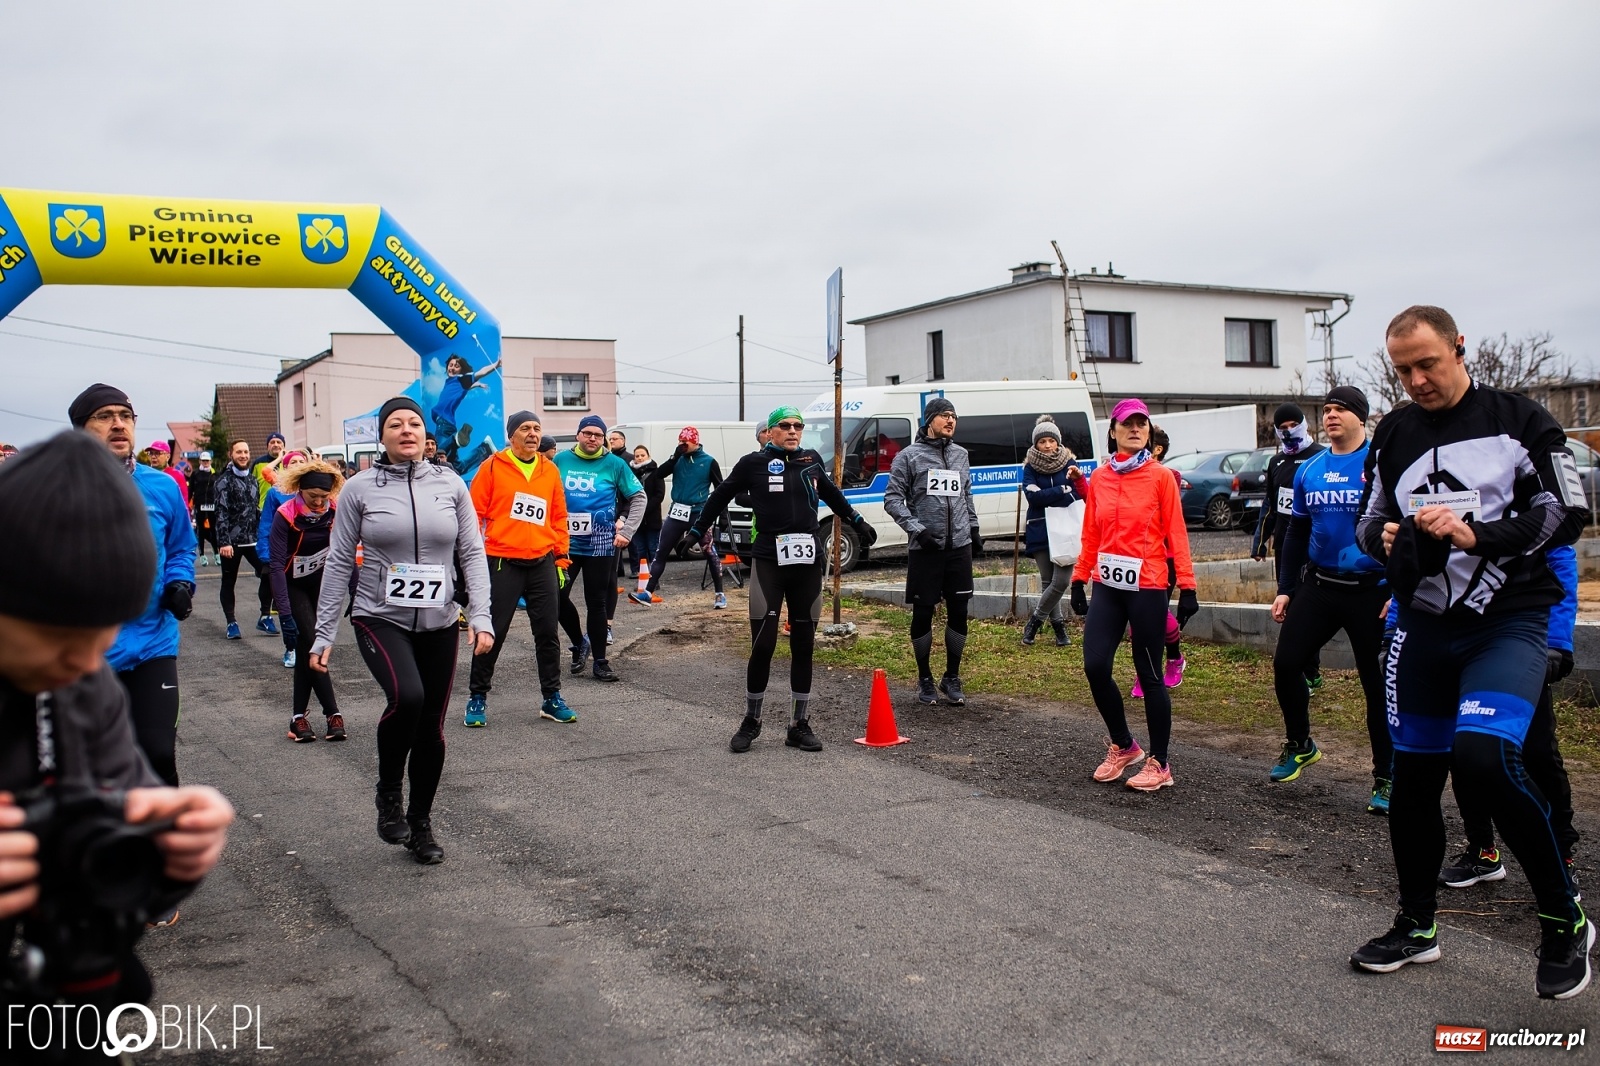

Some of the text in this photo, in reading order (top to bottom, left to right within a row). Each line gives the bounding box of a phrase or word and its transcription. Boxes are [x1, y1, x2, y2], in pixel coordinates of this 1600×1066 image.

[153, 208, 254, 224] Gmina
[129, 224, 281, 246] Pietrowice
[149, 247, 262, 267] Wielkie
[385, 235, 478, 325] Gmina ludzi
[370, 256, 460, 339] aktywnych
[929, 478, 959, 491] 218
[977, 470, 1017, 482] SANITARNY
[1305, 489, 1364, 506] UNNE
[513, 501, 545, 520] 350
[671, 508, 689, 519] 254
[780, 544, 814, 559] 133
[1100, 564, 1137, 585] 360
[389, 578, 443, 600] 227
[1385, 627, 1407, 728] RUNNERS
